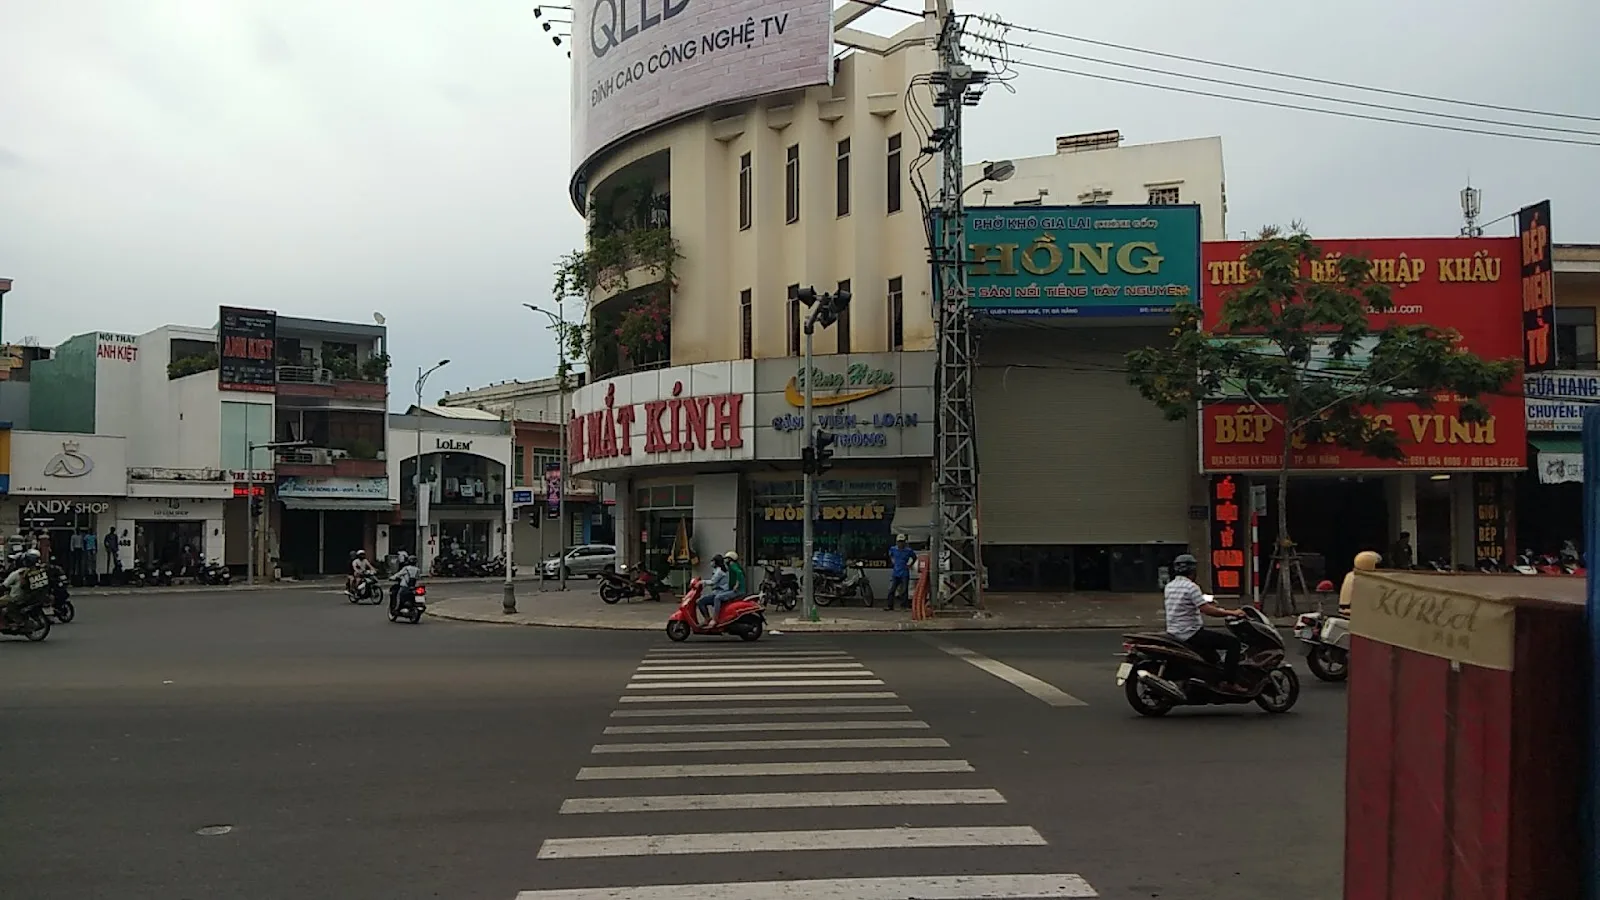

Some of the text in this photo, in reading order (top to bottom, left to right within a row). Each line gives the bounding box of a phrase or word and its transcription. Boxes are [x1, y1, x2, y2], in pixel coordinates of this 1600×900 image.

[616, 62, 644, 89] CAO
[648, 40, 697, 73] CÔNG
[702, 16, 755, 55] NGHỆ
[761, 13, 788, 38] TV
[1008, 215, 1038, 230] KHÔ
[1042, 217, 1065, 230] GIA
[1067, 217, 1091, 230] LAI
[968, 233, 1164, 275] HỒNG
[1310, 251, 1347, 284] BẾ
[1365, 251, 1426, 288] NHẬP
[1438, 249, 1501, 283] KHẨU
[1092, 284, 1121, 297] TÂY
[97, 344, 138, 363] ANH KIỆT
[587, 383, 635, 460] MẮT
[644, 381, 743, 454] KÍNH
[1214, 404, 1273, 444] BẾP
[1407, 414, 1496, 445] VINH
[24, 500, 109, 514] ANDY SHOP
